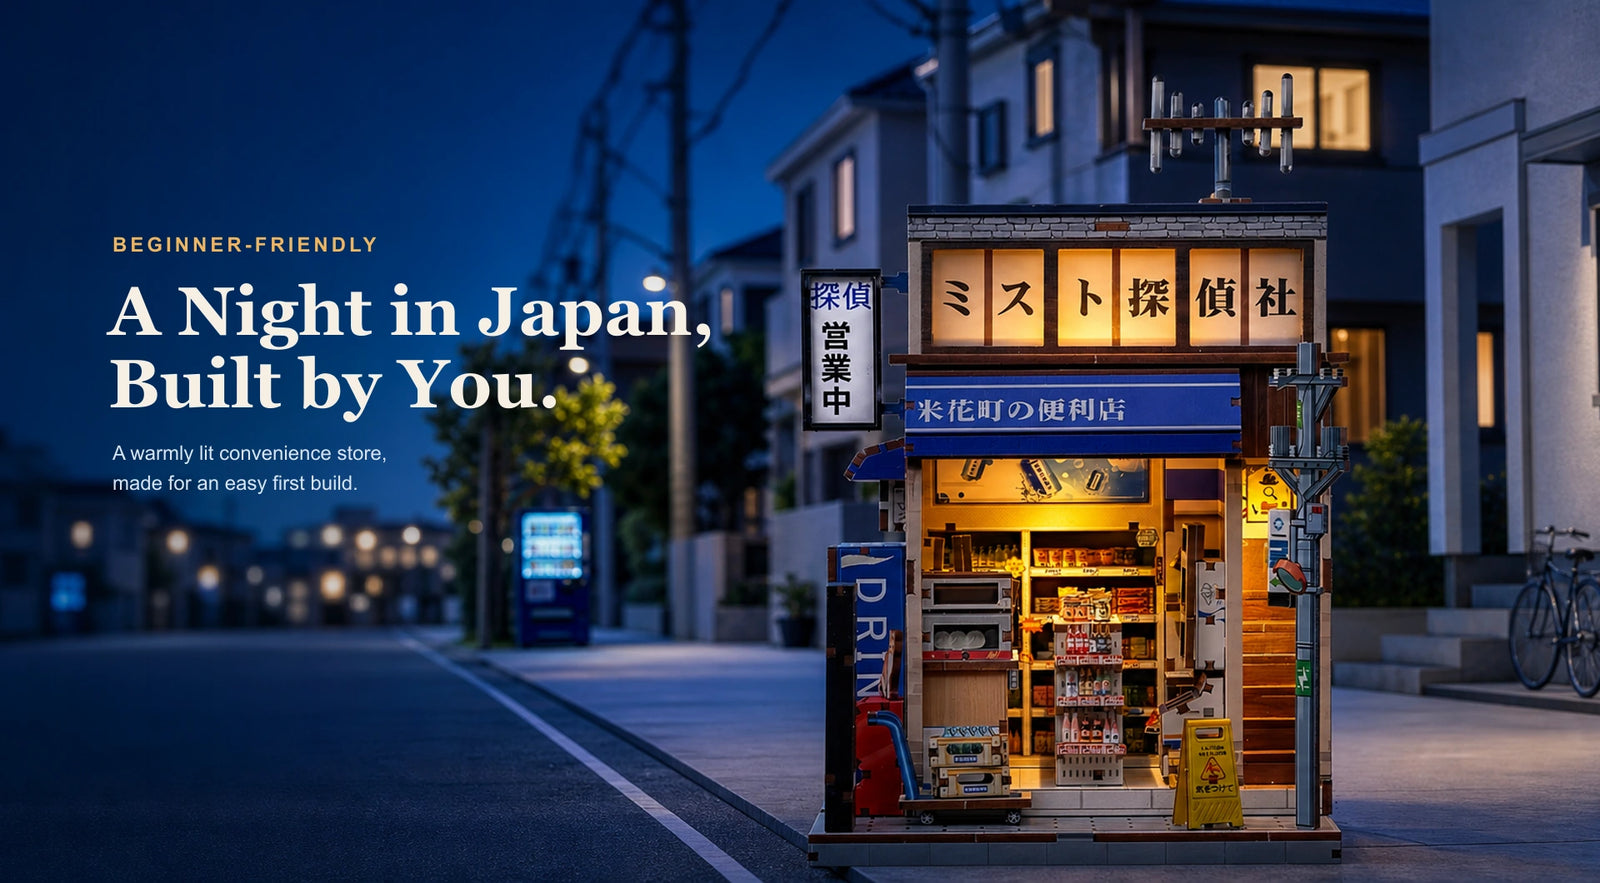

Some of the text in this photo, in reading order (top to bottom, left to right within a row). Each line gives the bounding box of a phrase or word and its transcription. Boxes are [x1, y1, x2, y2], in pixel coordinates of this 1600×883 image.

[810, 282, 872, 311] 探偵
[944, 277, 1298, 318] ミスト探偵社
[821, 321, 852, 416] 営業中
[917, 397, 1127, 422] 米花町の便利店
